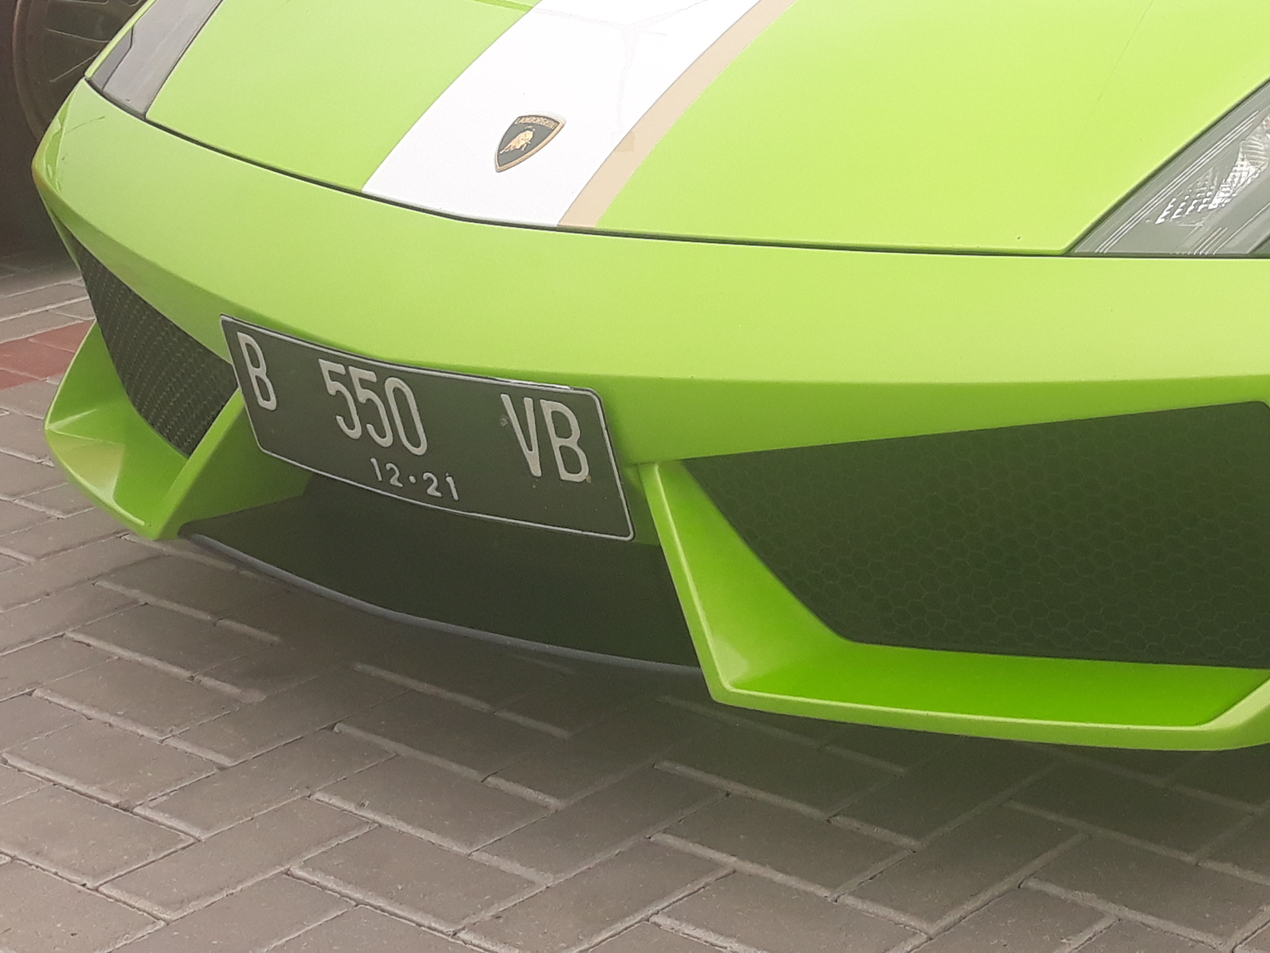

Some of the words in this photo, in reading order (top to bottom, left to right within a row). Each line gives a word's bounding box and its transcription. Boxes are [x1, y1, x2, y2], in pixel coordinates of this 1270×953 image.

[237, 331, 277, 411] B
[318, 358, 428, 456] 550
[500, 393, 590, 483] VB
